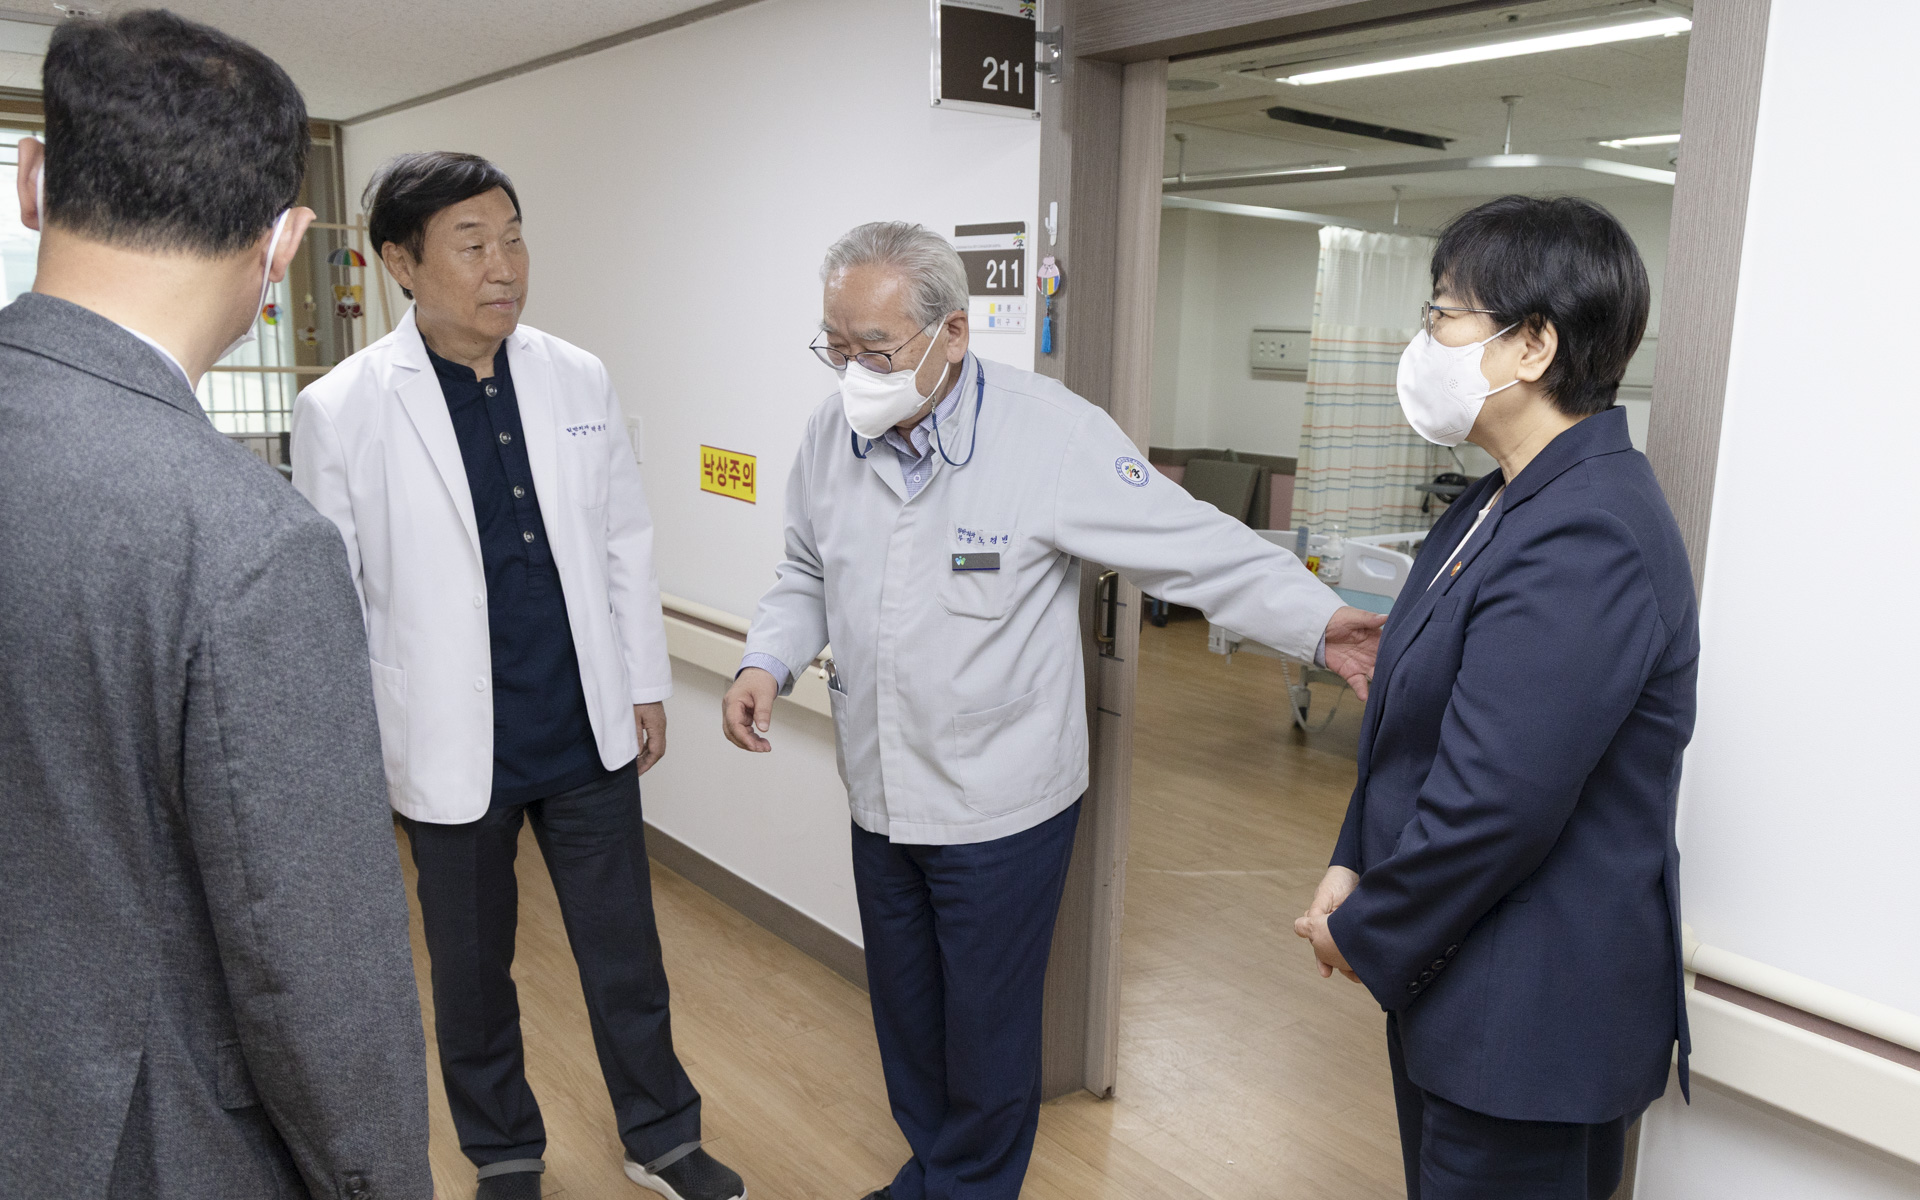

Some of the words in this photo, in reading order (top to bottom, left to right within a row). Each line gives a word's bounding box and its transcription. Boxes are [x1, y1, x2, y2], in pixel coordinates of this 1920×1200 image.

[982, 56, 1023, 94] 211
[986, 259, 1019, 288] 211
[703, 453, 754, 494] 낙상주의
